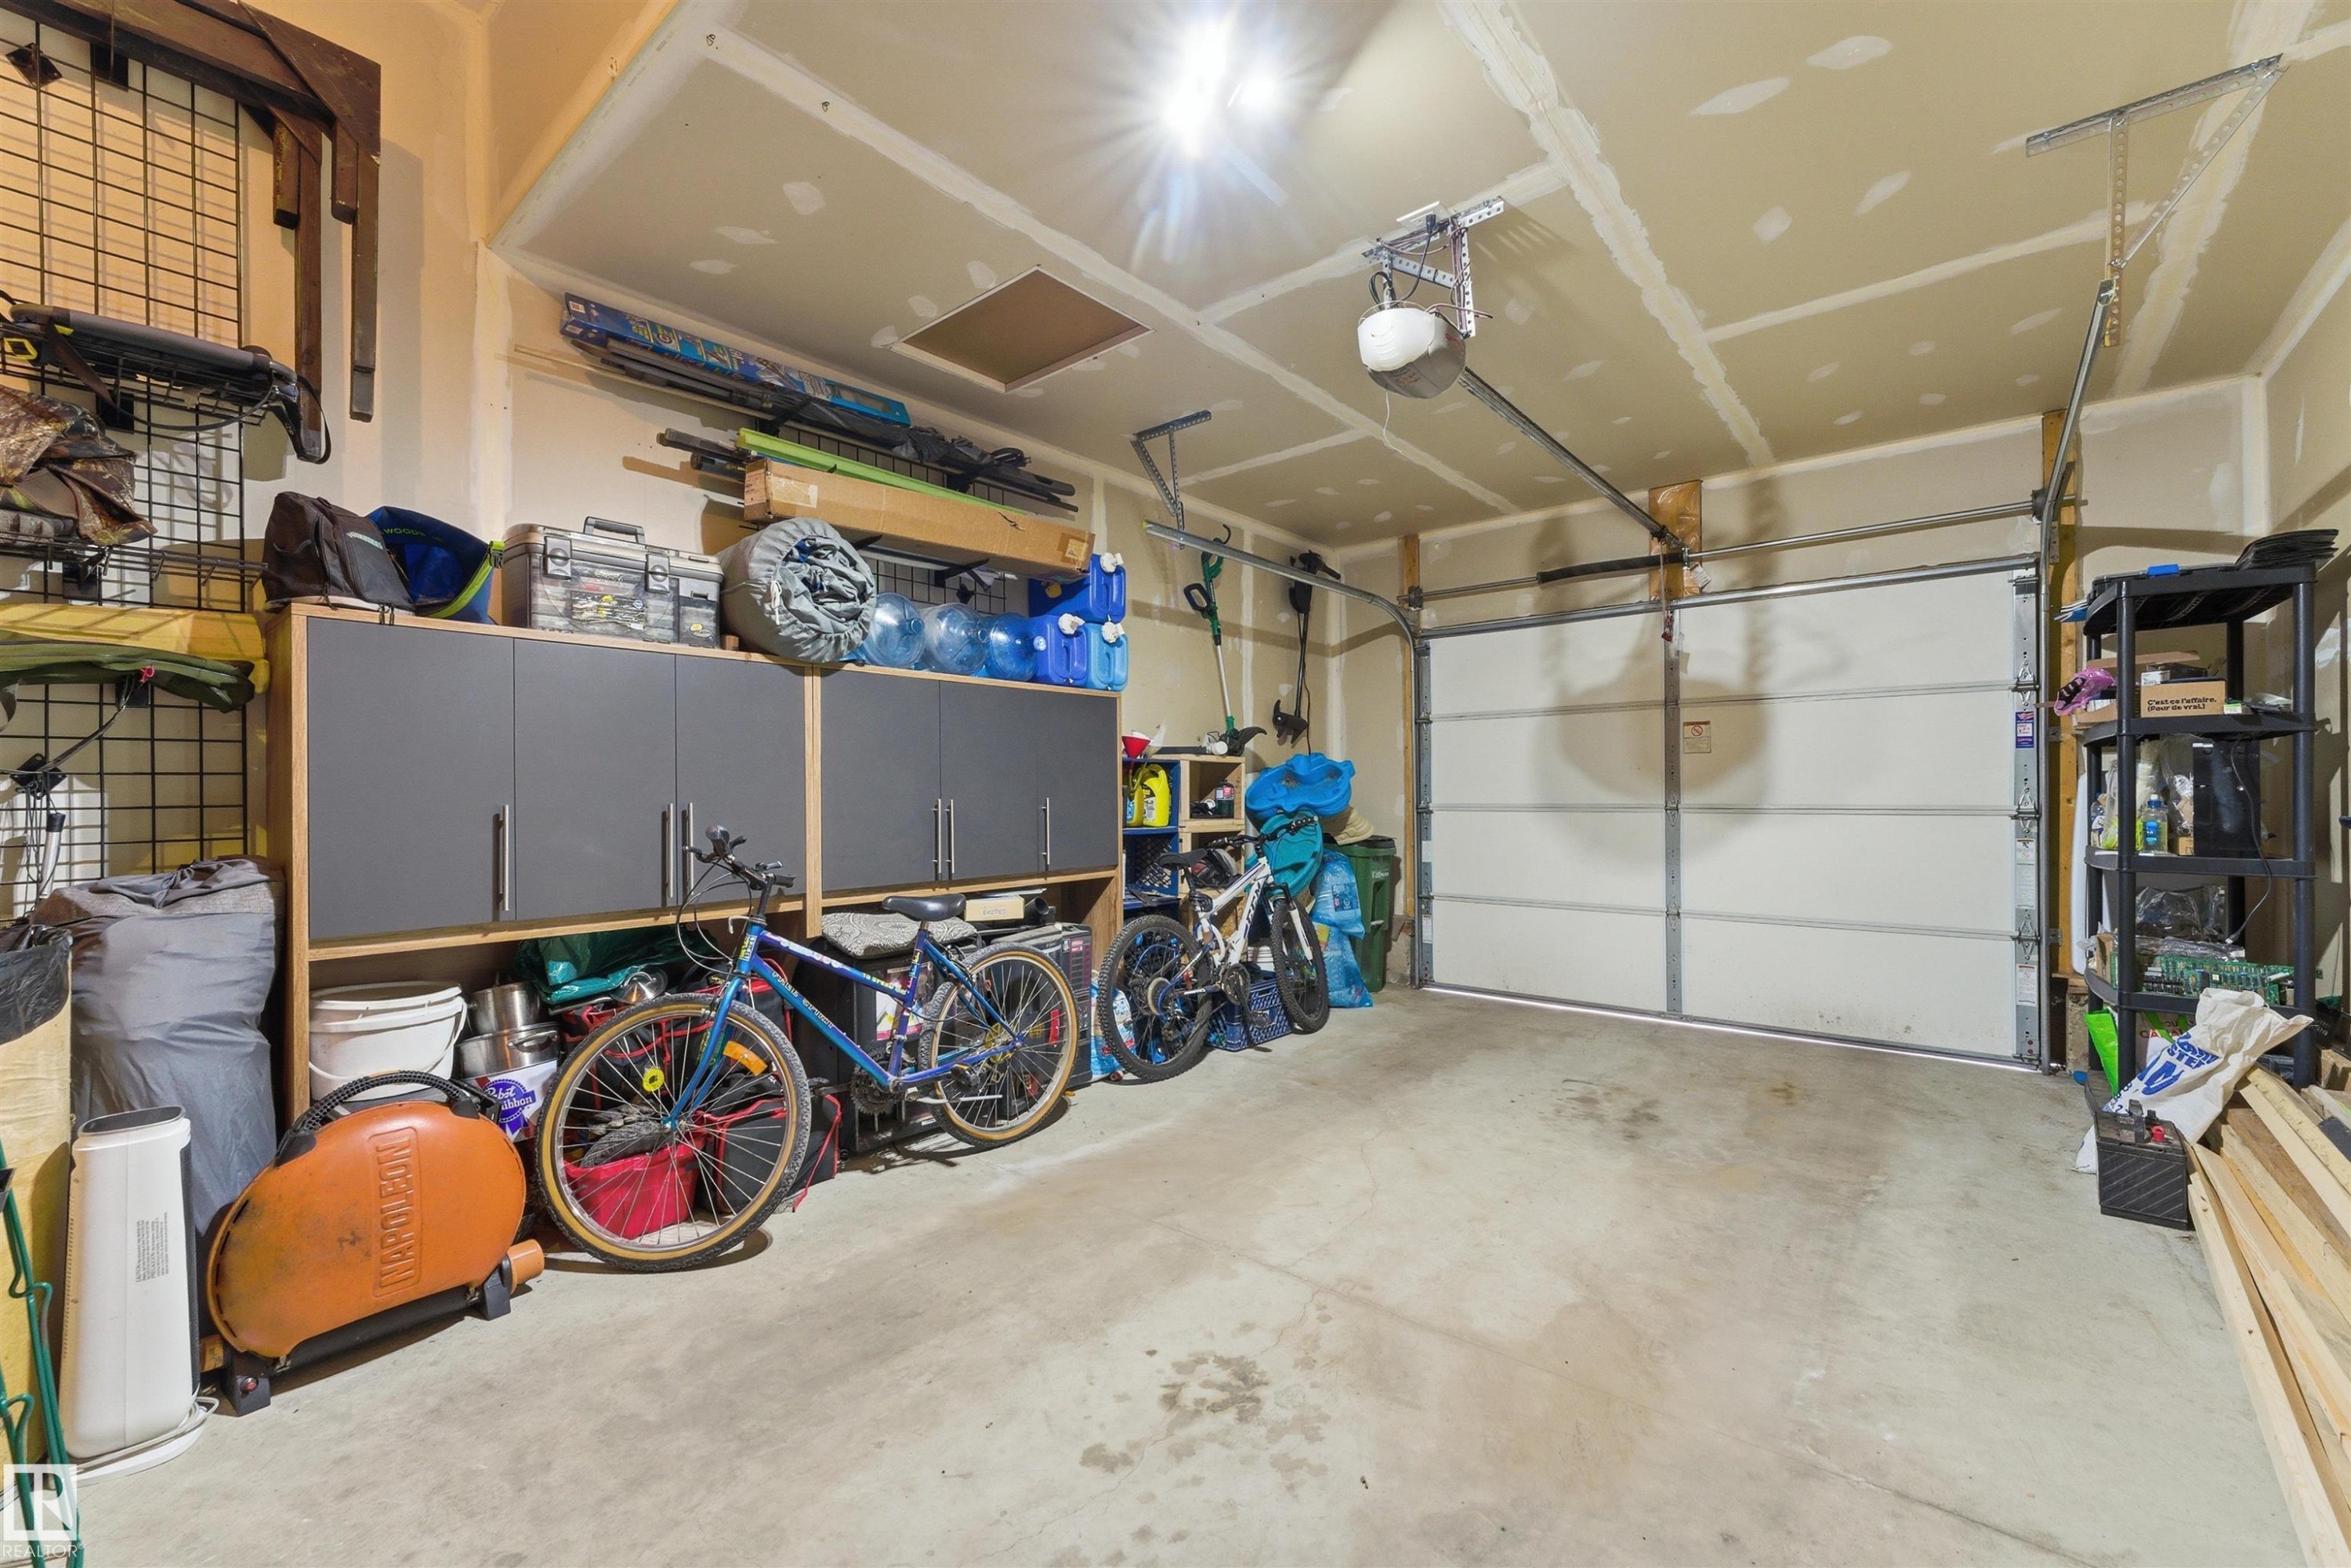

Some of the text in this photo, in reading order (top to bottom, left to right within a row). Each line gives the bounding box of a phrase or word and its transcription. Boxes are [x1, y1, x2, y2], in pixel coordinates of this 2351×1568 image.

[485, 1085, 516, 1099] Pbst
[502, 1096, 533, 1110] ibbon
[375, 1139, 415, 1288] NAPOLEON
